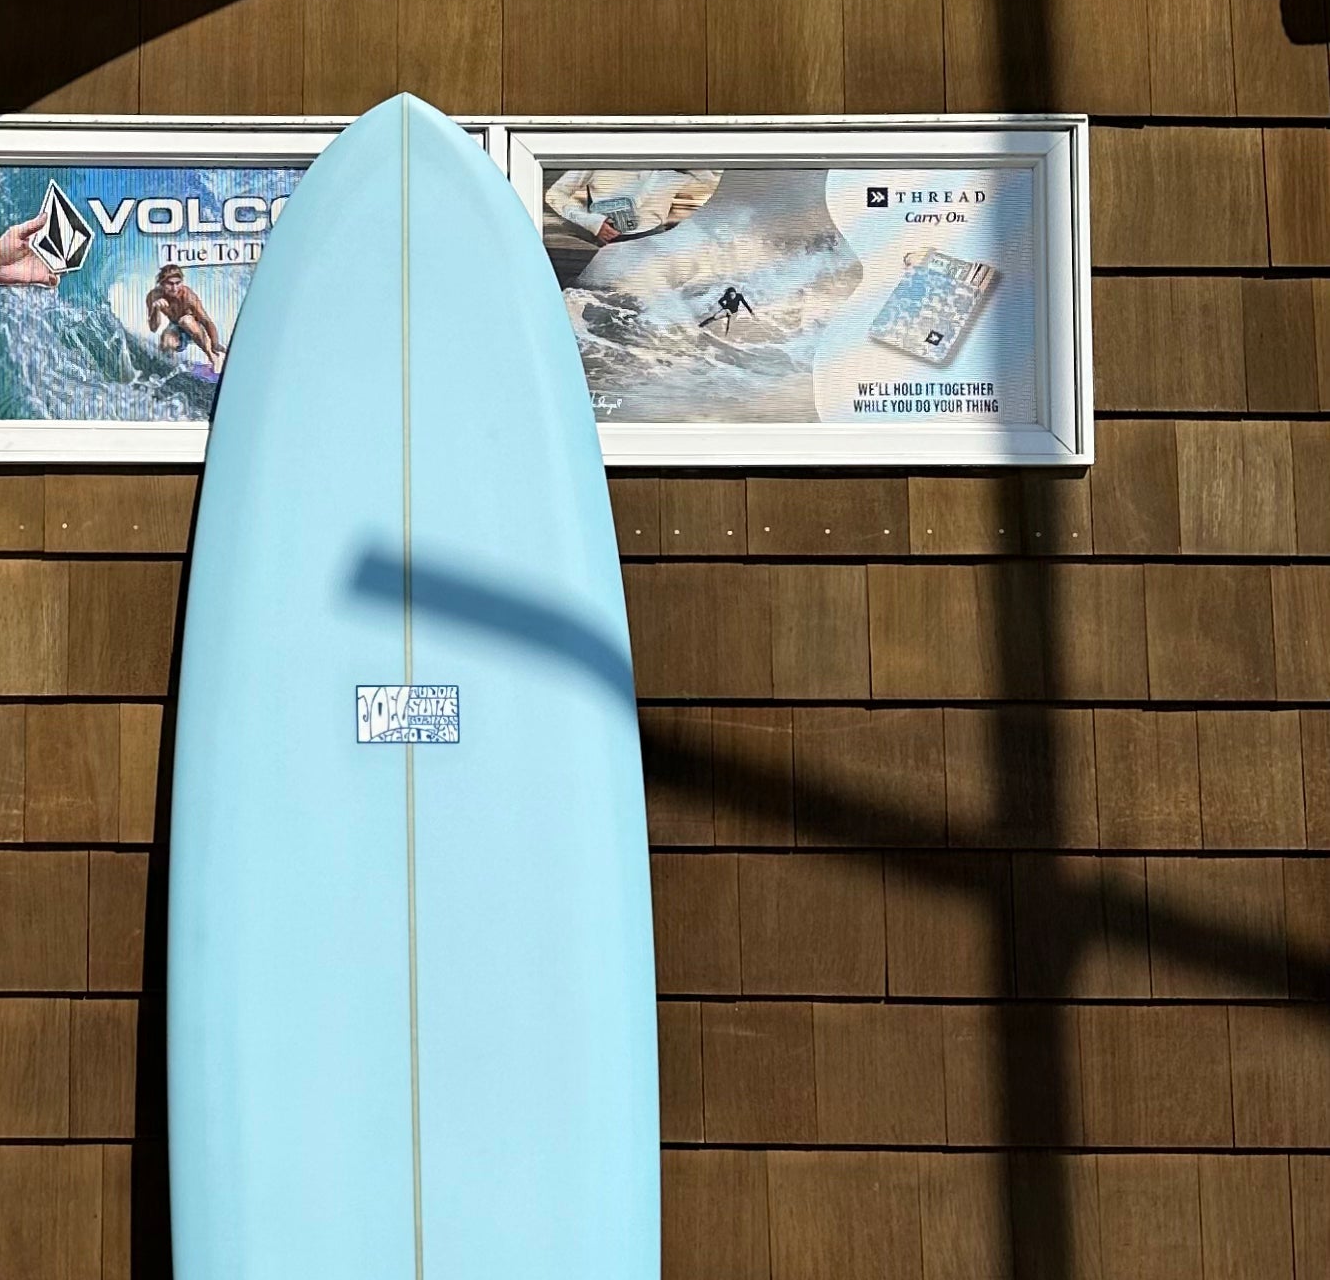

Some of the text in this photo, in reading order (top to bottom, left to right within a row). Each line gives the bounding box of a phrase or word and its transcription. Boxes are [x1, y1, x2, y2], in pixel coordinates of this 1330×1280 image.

[895, 190, 986, 204] THREAD
[88, 194, 291, 236] VOLC
[905, 211, 943, 226] Carry
[162, 244, 207, 262] True
[214, 243, 239, 261] To
[858, 382, 994, 397] WE'LL HOLD IT TOGETHER
[853, 399, 999, 413] WHILE YOU DO YOUR THING
[410, 687, 458, 698] TUDOR
